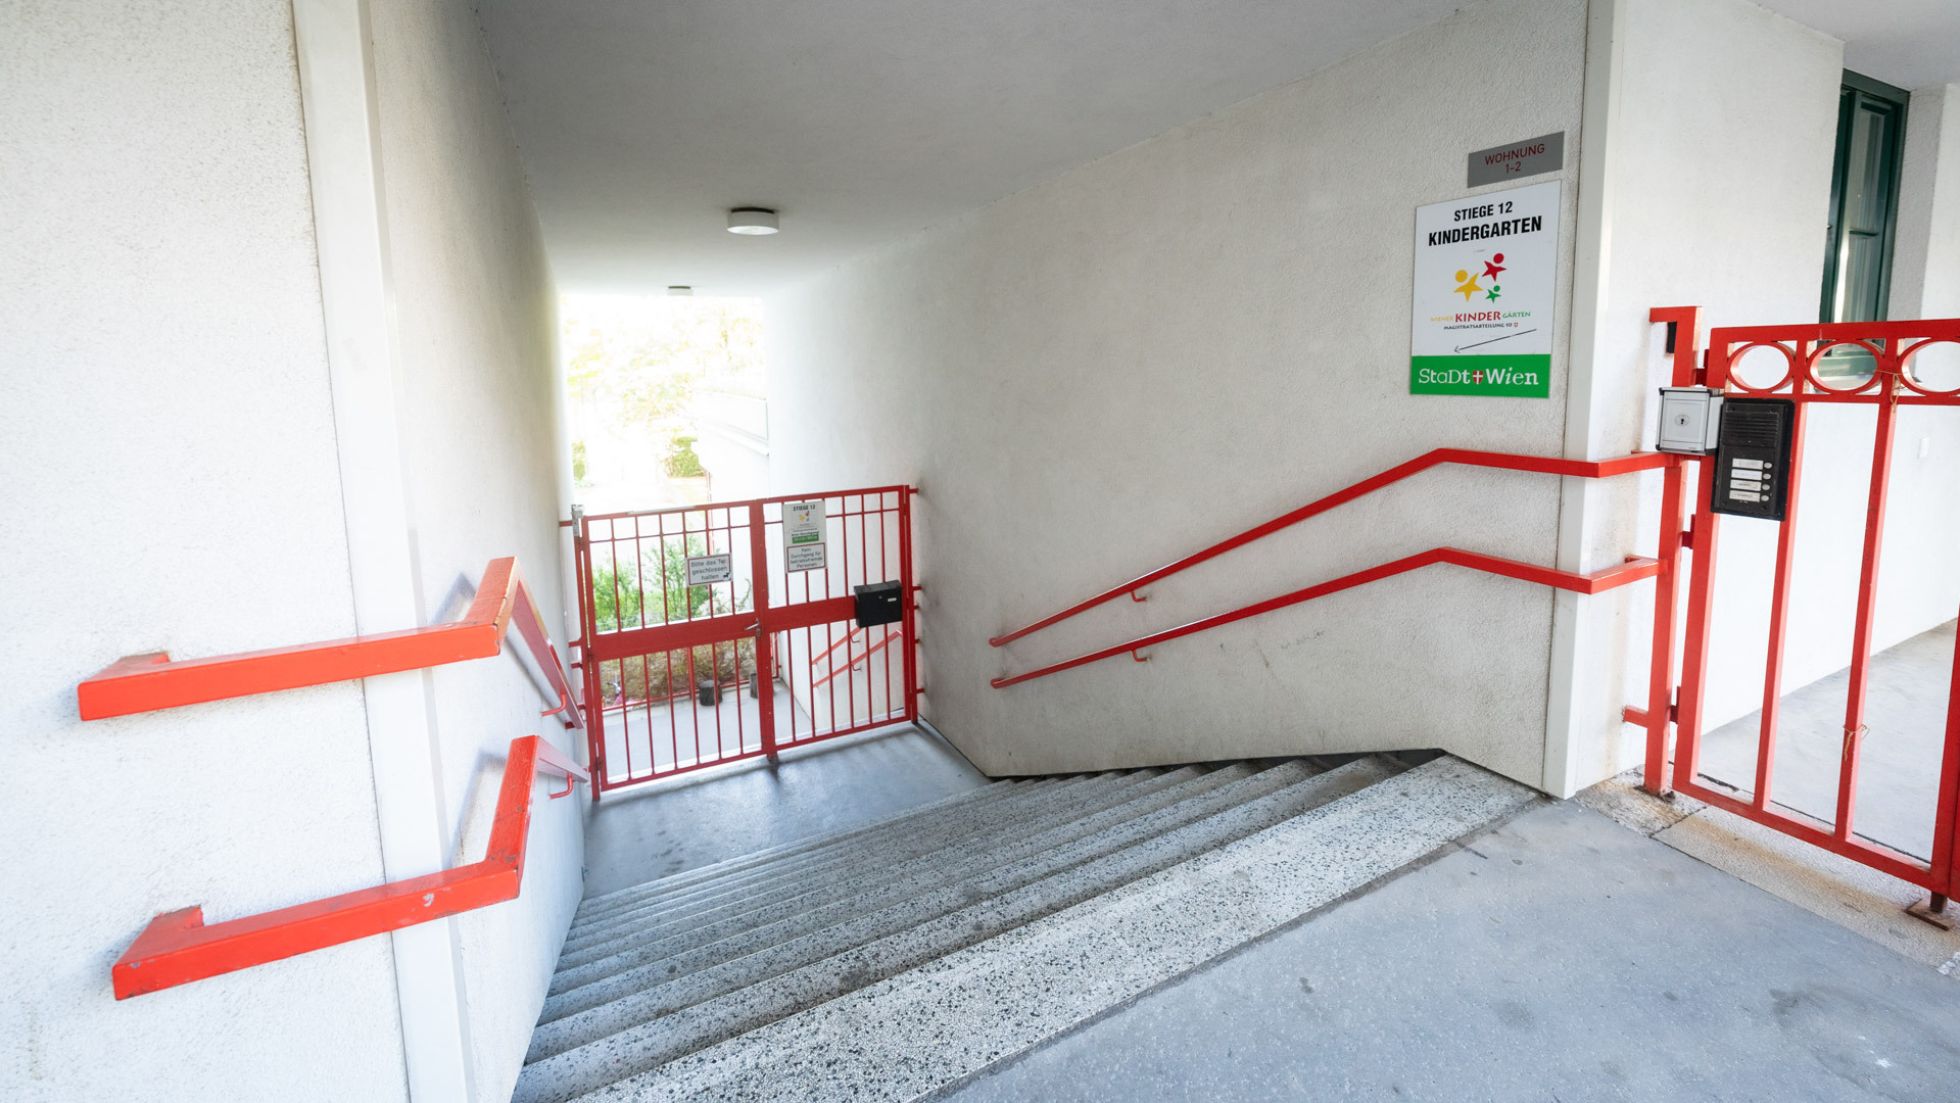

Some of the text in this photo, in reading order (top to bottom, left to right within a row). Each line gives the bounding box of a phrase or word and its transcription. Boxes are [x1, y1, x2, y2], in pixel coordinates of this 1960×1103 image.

[1484, 143, 1545, 166] WOHNUNG
[1505, 161, 1522, 174] 1-2
[1453, 201, 1513, 222] STIEGE 12
[1428, 215, 1543, 246] KINDERGARTEN
[1455, 311, 1501, 322] KINDER
[1487, 368, 1539, 385] Wien
[692, 566, 727, 575] geschlossen
